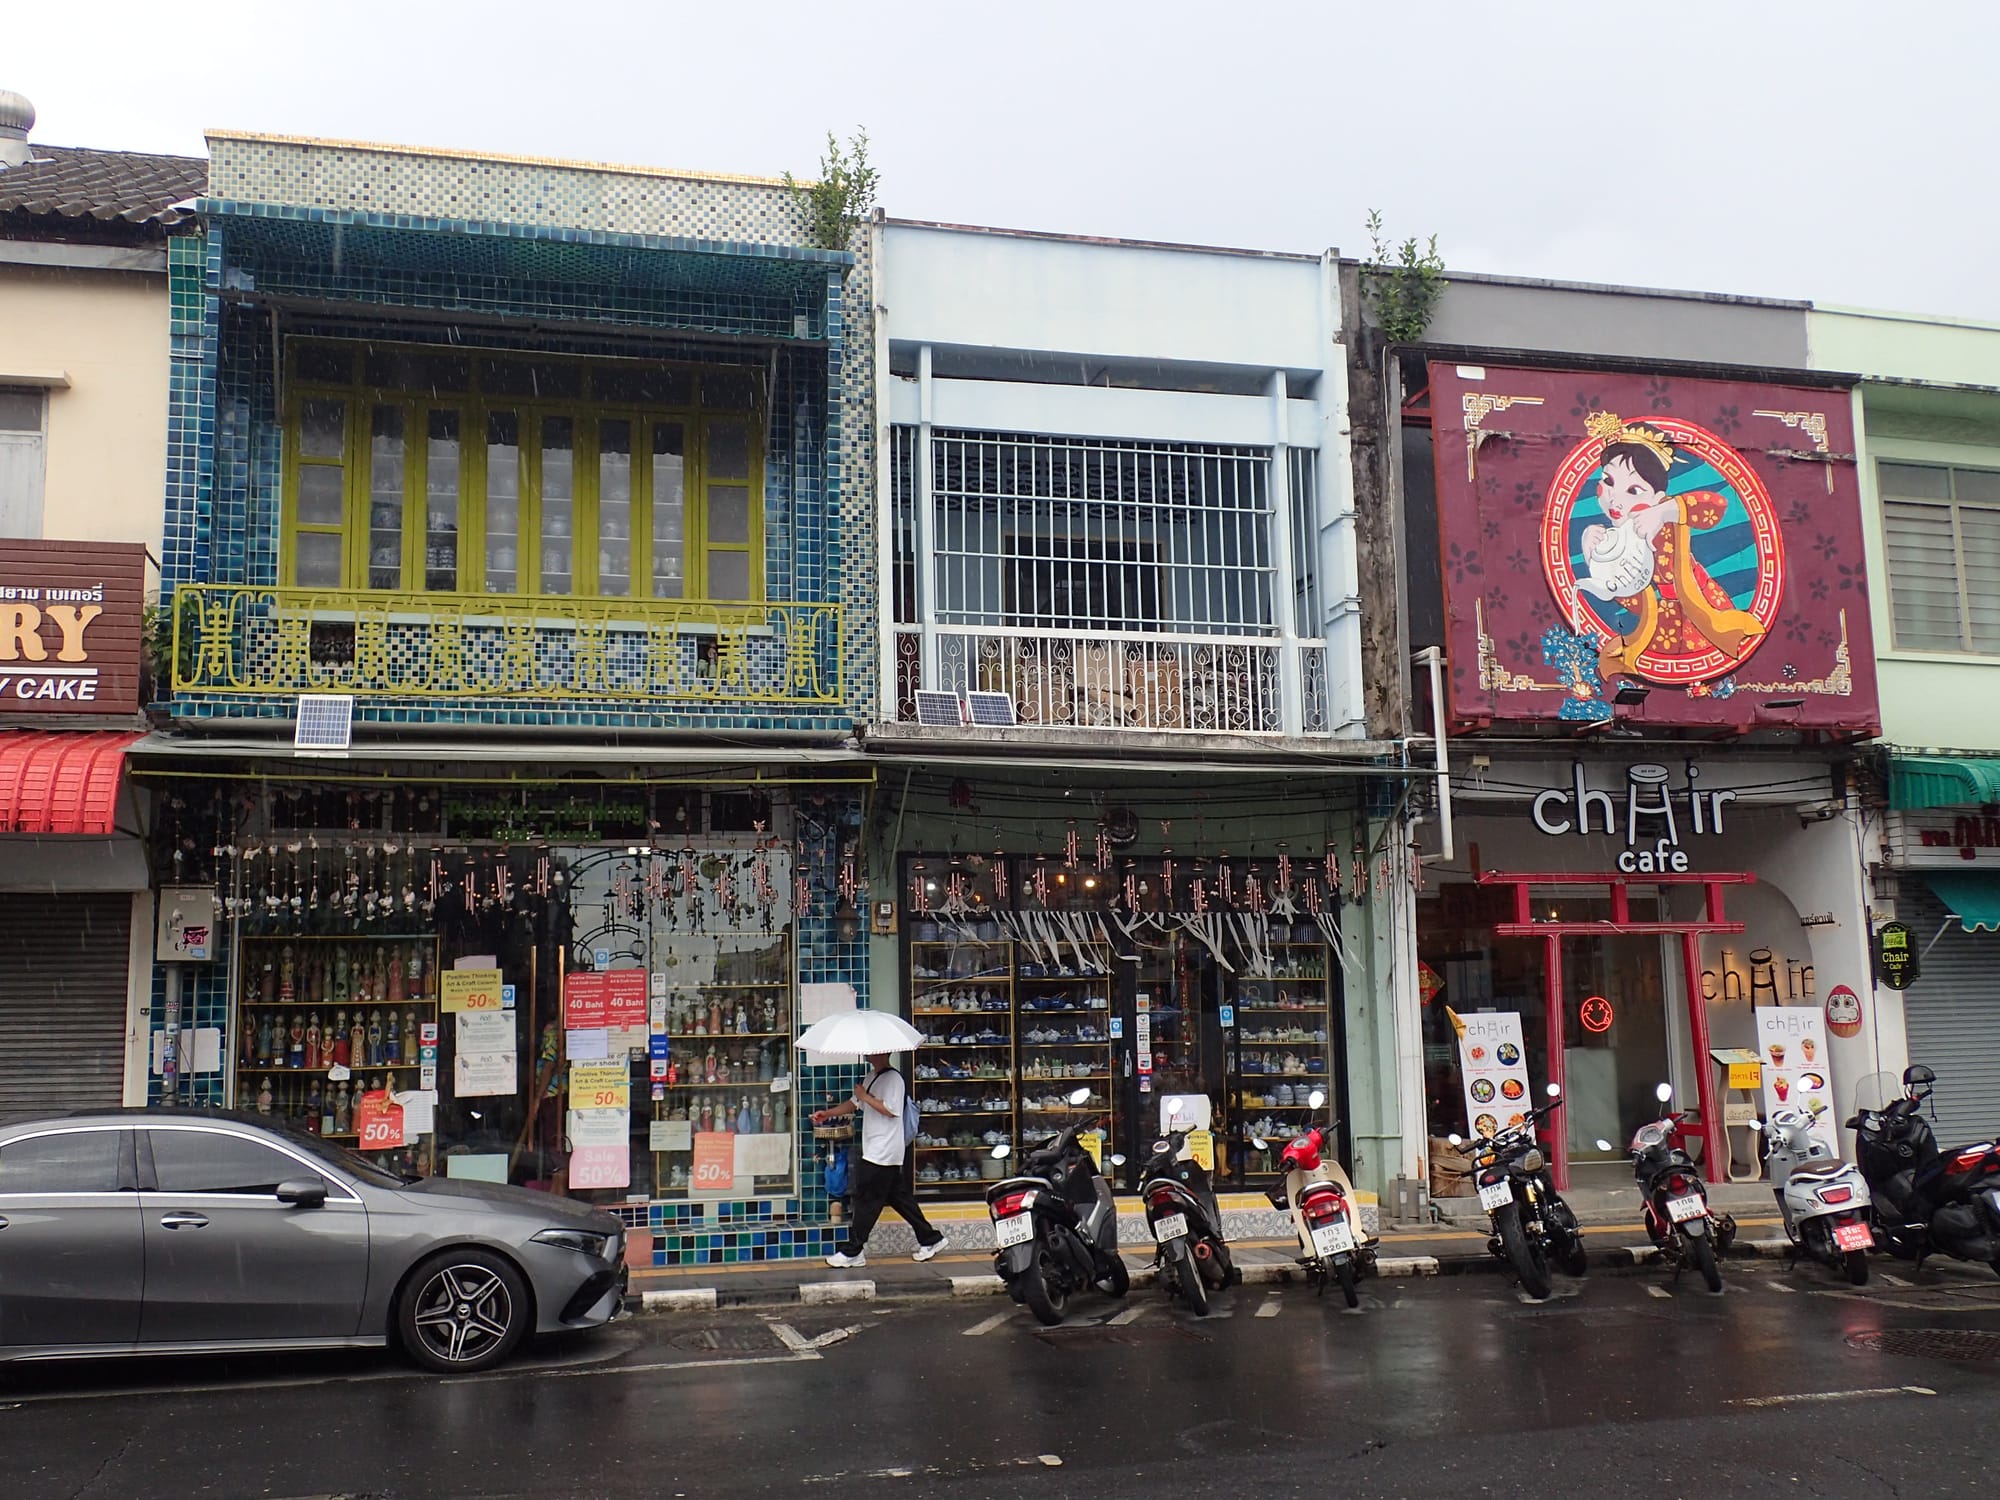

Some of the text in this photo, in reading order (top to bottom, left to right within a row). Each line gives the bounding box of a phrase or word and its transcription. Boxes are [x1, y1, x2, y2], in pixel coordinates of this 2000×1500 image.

[46, 582, 103, 601] เบเกอรี่
[16, 678, 98, 700] CAKE
[1617, 839, 1688, 873] cafe
[1882, 952, 1909, 963] Chair
[569, 1000, 604, 1009] 40 Baht
[610, 997, 644, 1007] 40 Baht
[584, 1150, 616, 1163] Sale
[578, 1167, 624, 1184] 50%
[1003, 1233, 1027, 1246] 9205
[1323, 1241, 1347, 1253] 5263
